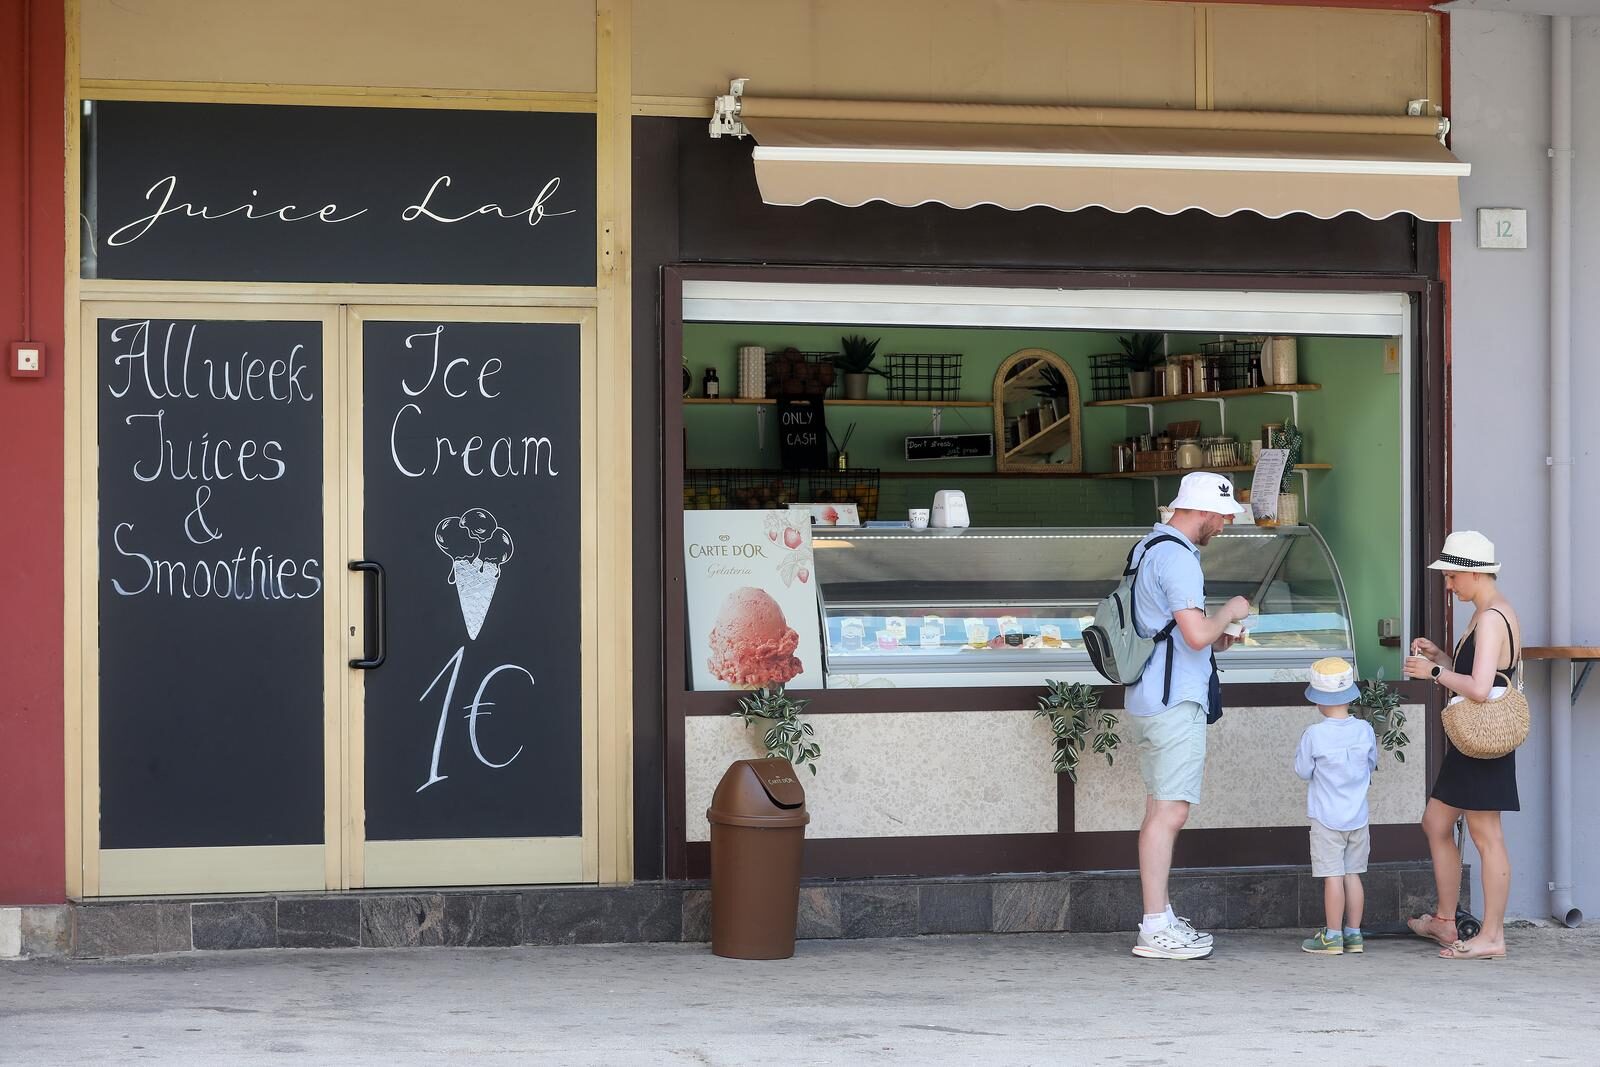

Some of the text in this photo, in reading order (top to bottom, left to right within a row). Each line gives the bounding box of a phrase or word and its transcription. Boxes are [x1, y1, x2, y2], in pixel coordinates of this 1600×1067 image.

[108, 175, 577, 247] Juice Lab
[1495, 220, 1513, 238] 12
[108, 320, 314, 404] All week
[401, 325, 503, 399] Ice
[126, 409, 286, 482] Juices
[390, 403, 560, 479] Cream
[782, 411, 813, 425] ONLY
[786, 432, 817, 446] CASH
[185, 486, 223, 545] &
[111, 521, 322, 599] Smoothies
[689, 543, 769, 559] CARTE D'OR
[706, 562, 752, 578] Gelateria
